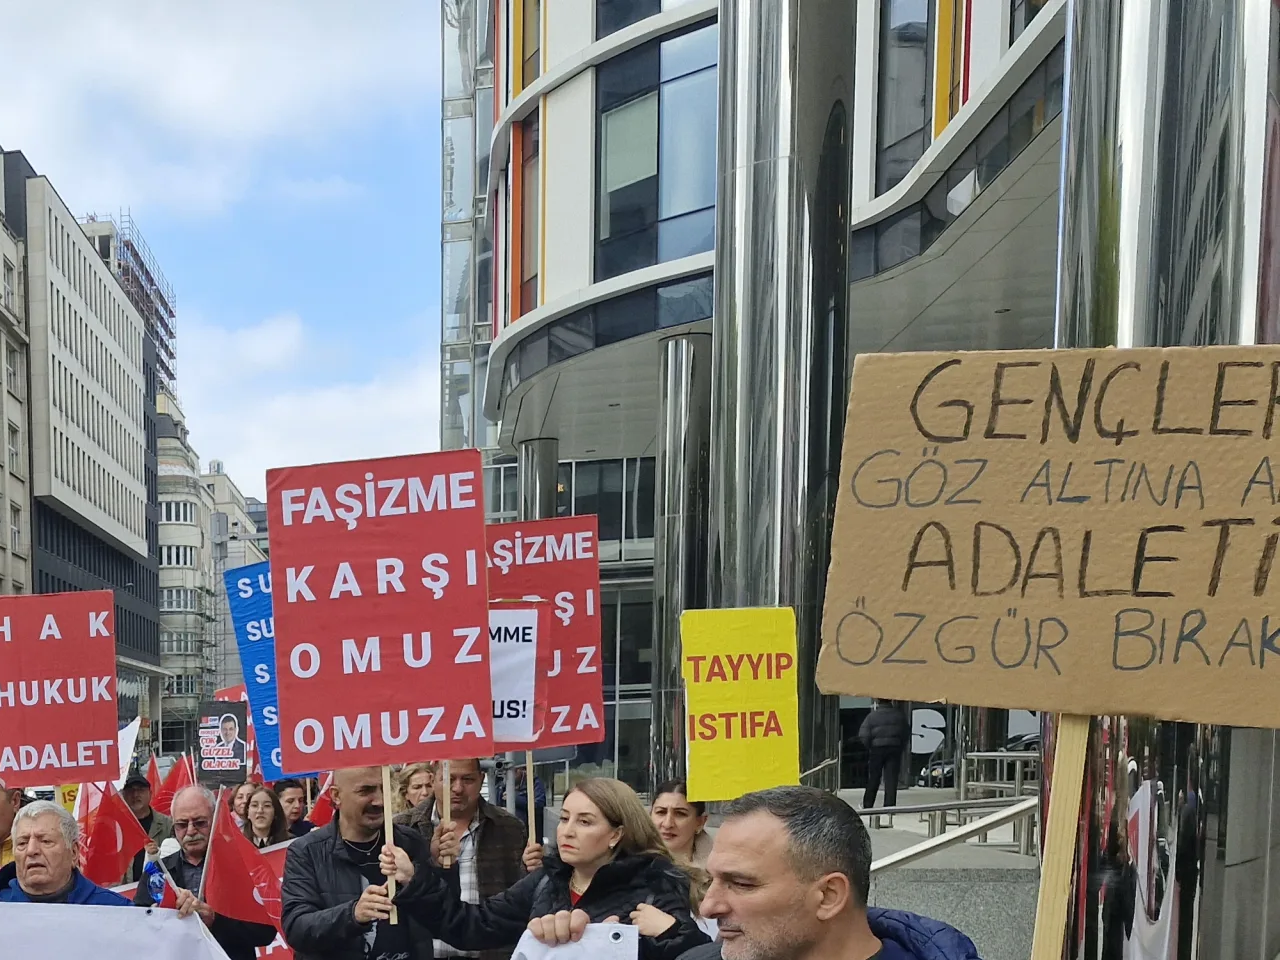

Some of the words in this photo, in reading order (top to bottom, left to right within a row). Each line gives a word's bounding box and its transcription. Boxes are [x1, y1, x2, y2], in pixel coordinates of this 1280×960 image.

[850, 446, 988, 509] GÖZ
[1020, 457, 1206, 510] ALTINA
[281, 471, 477, 531] FAŞİZME
[486, 530, 595, 575] ŞİZME
[835, 596, 1070, 676] ÖZGÜR
[686, 652, 794, 684] TAYYIP
[293, 703, 487, 755] OMUZA
[688, 710, 784, 742] ISTIFA
[202, 746, 233, 757] GÜZEL
[203, 759, 240, 769] OLACAK
